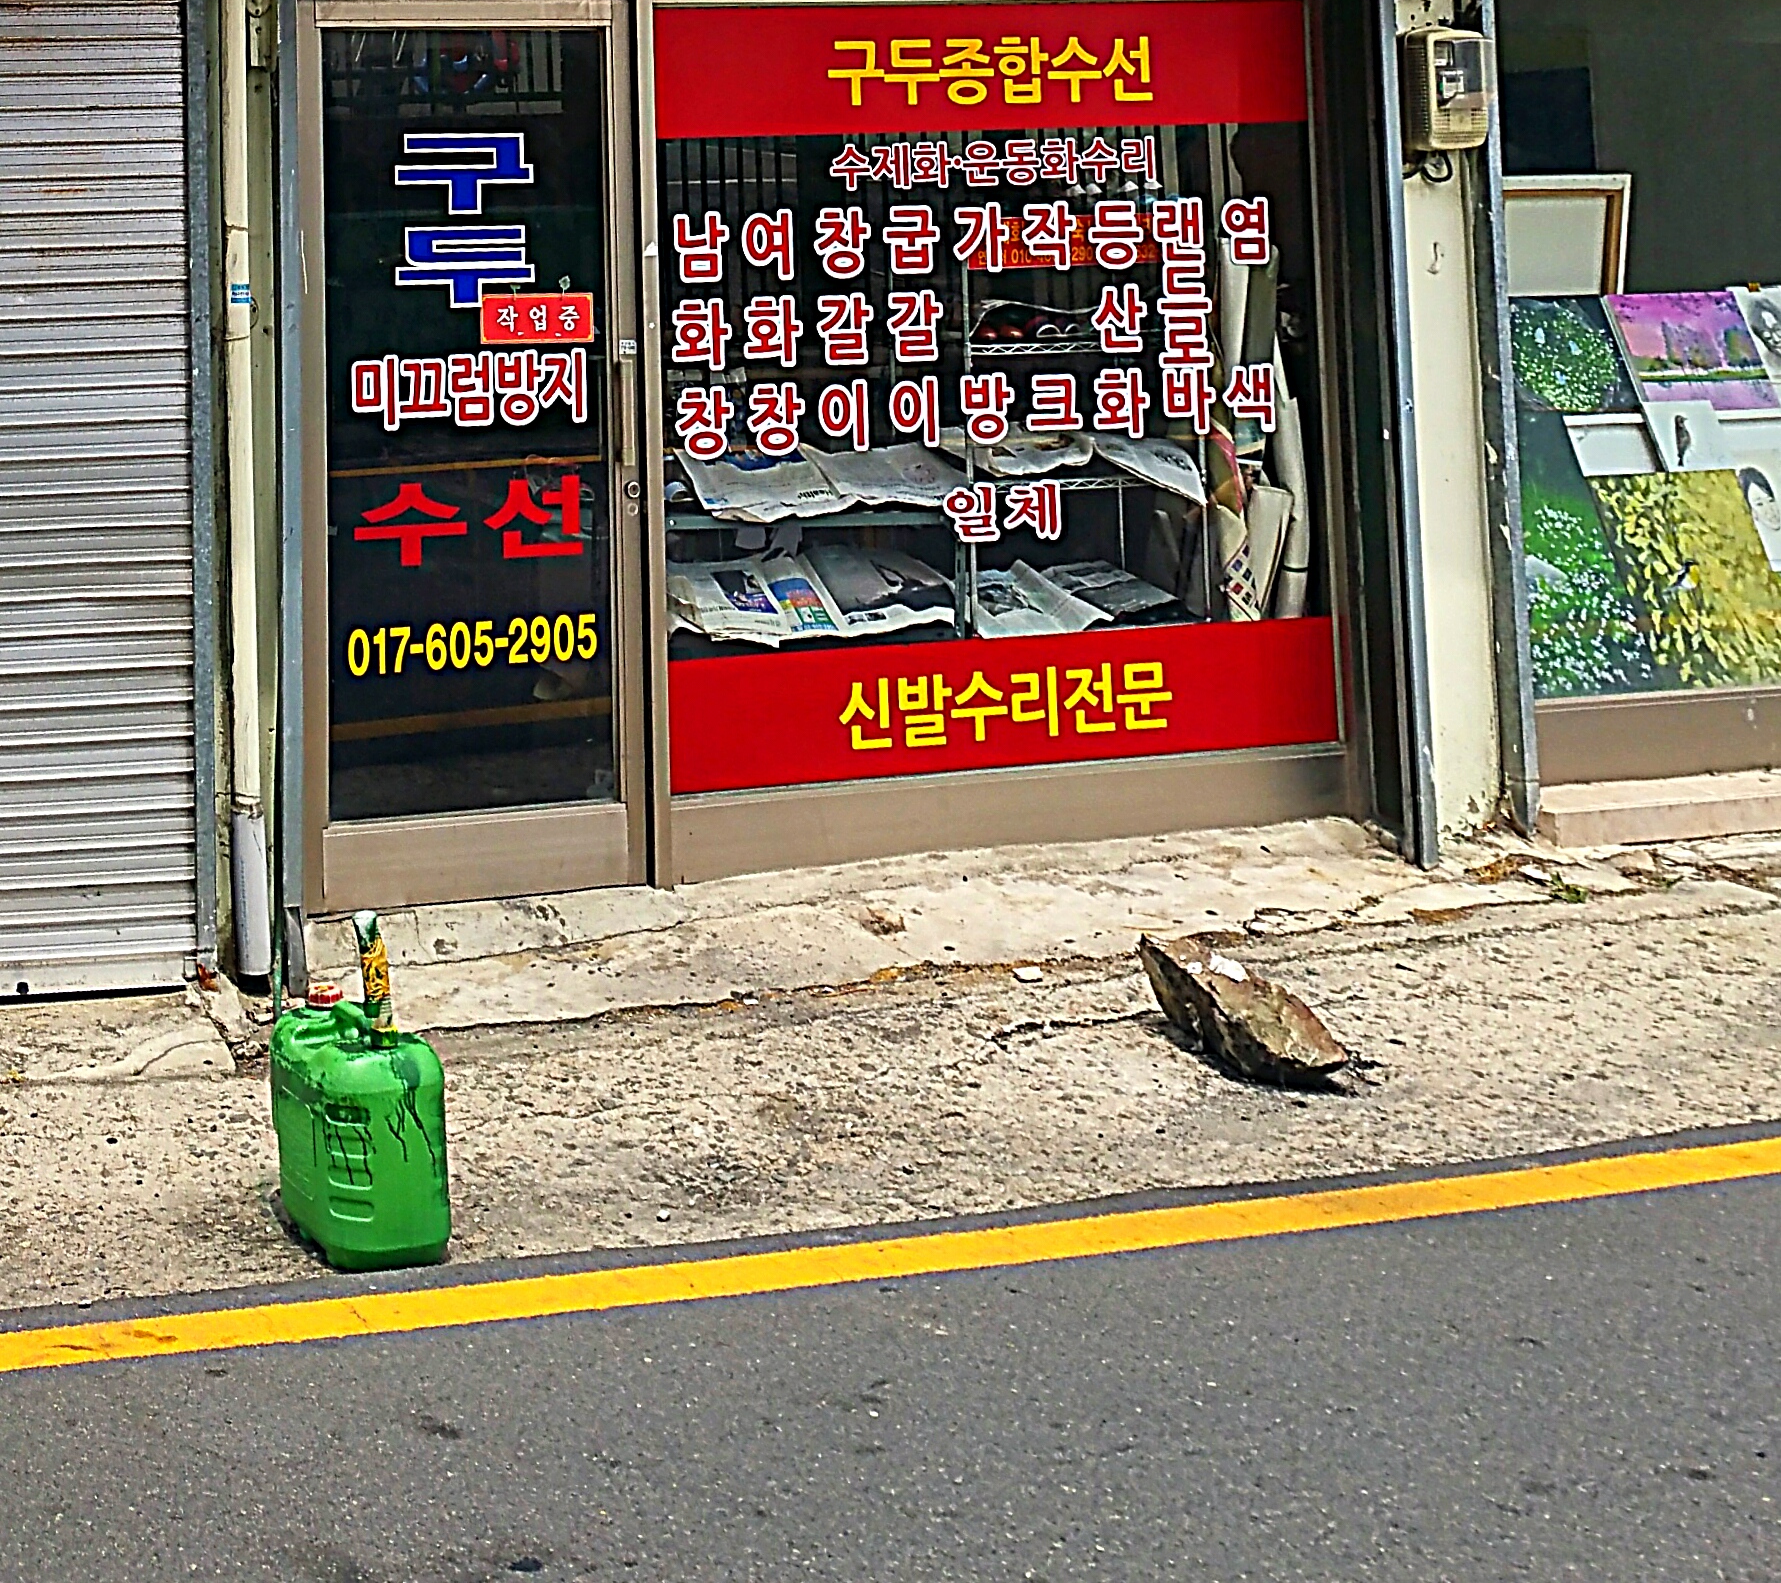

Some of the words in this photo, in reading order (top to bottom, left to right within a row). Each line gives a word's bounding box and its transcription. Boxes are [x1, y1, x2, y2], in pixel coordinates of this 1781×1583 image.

[827, 36, 1154, 107] 구두종합수선
[351, 347, 588, 432] 미끄럼방지
[942, 478, 1062, 543] 일체
[347, 613, 598, 676] 017-605-2905
[839, 661, 1174, 751] 신발수리전문
